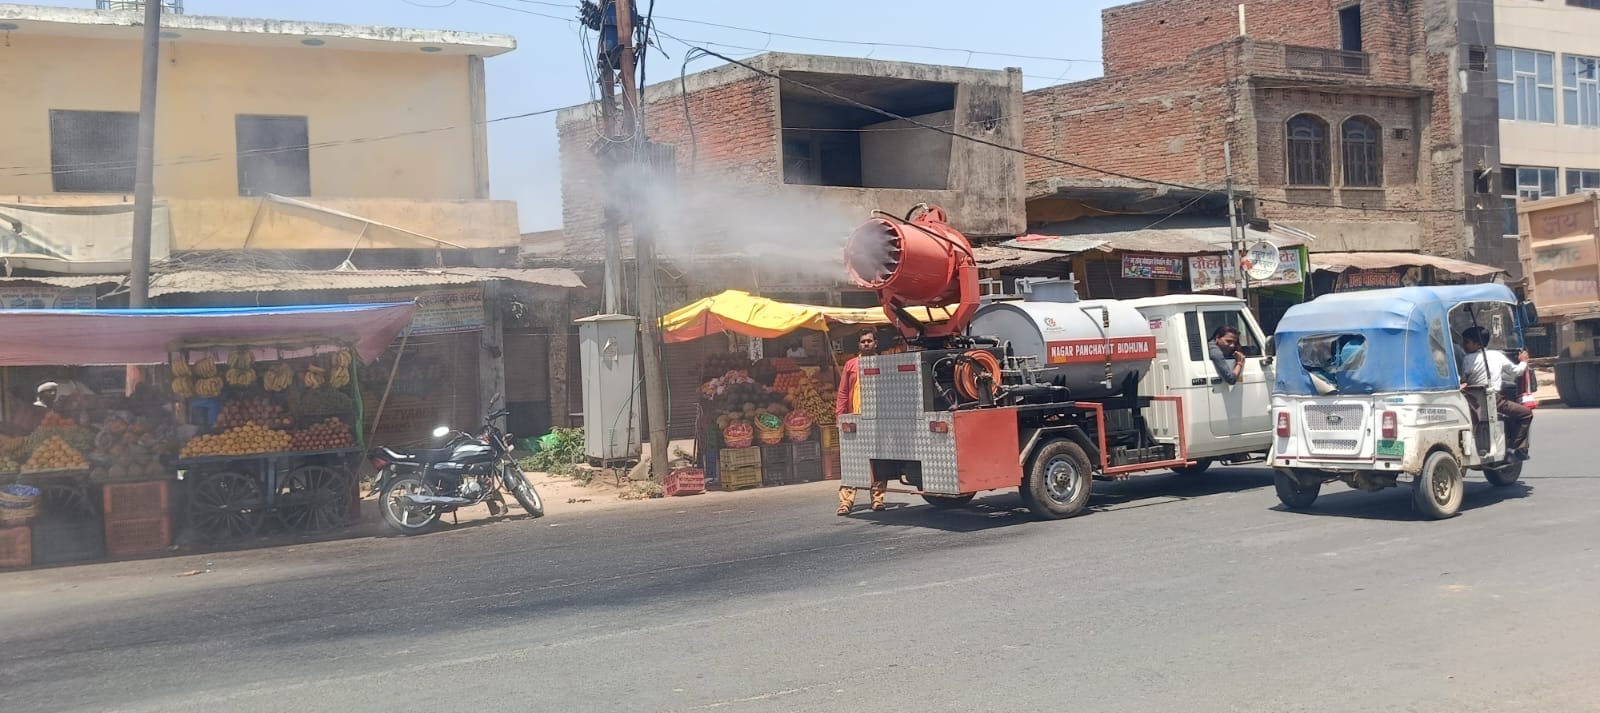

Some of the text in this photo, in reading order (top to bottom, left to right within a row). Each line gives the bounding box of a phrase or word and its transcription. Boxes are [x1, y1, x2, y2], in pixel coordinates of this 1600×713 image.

[1051, 341, 1149, 357] NAGAR PANCHAYT BIDHUNA
